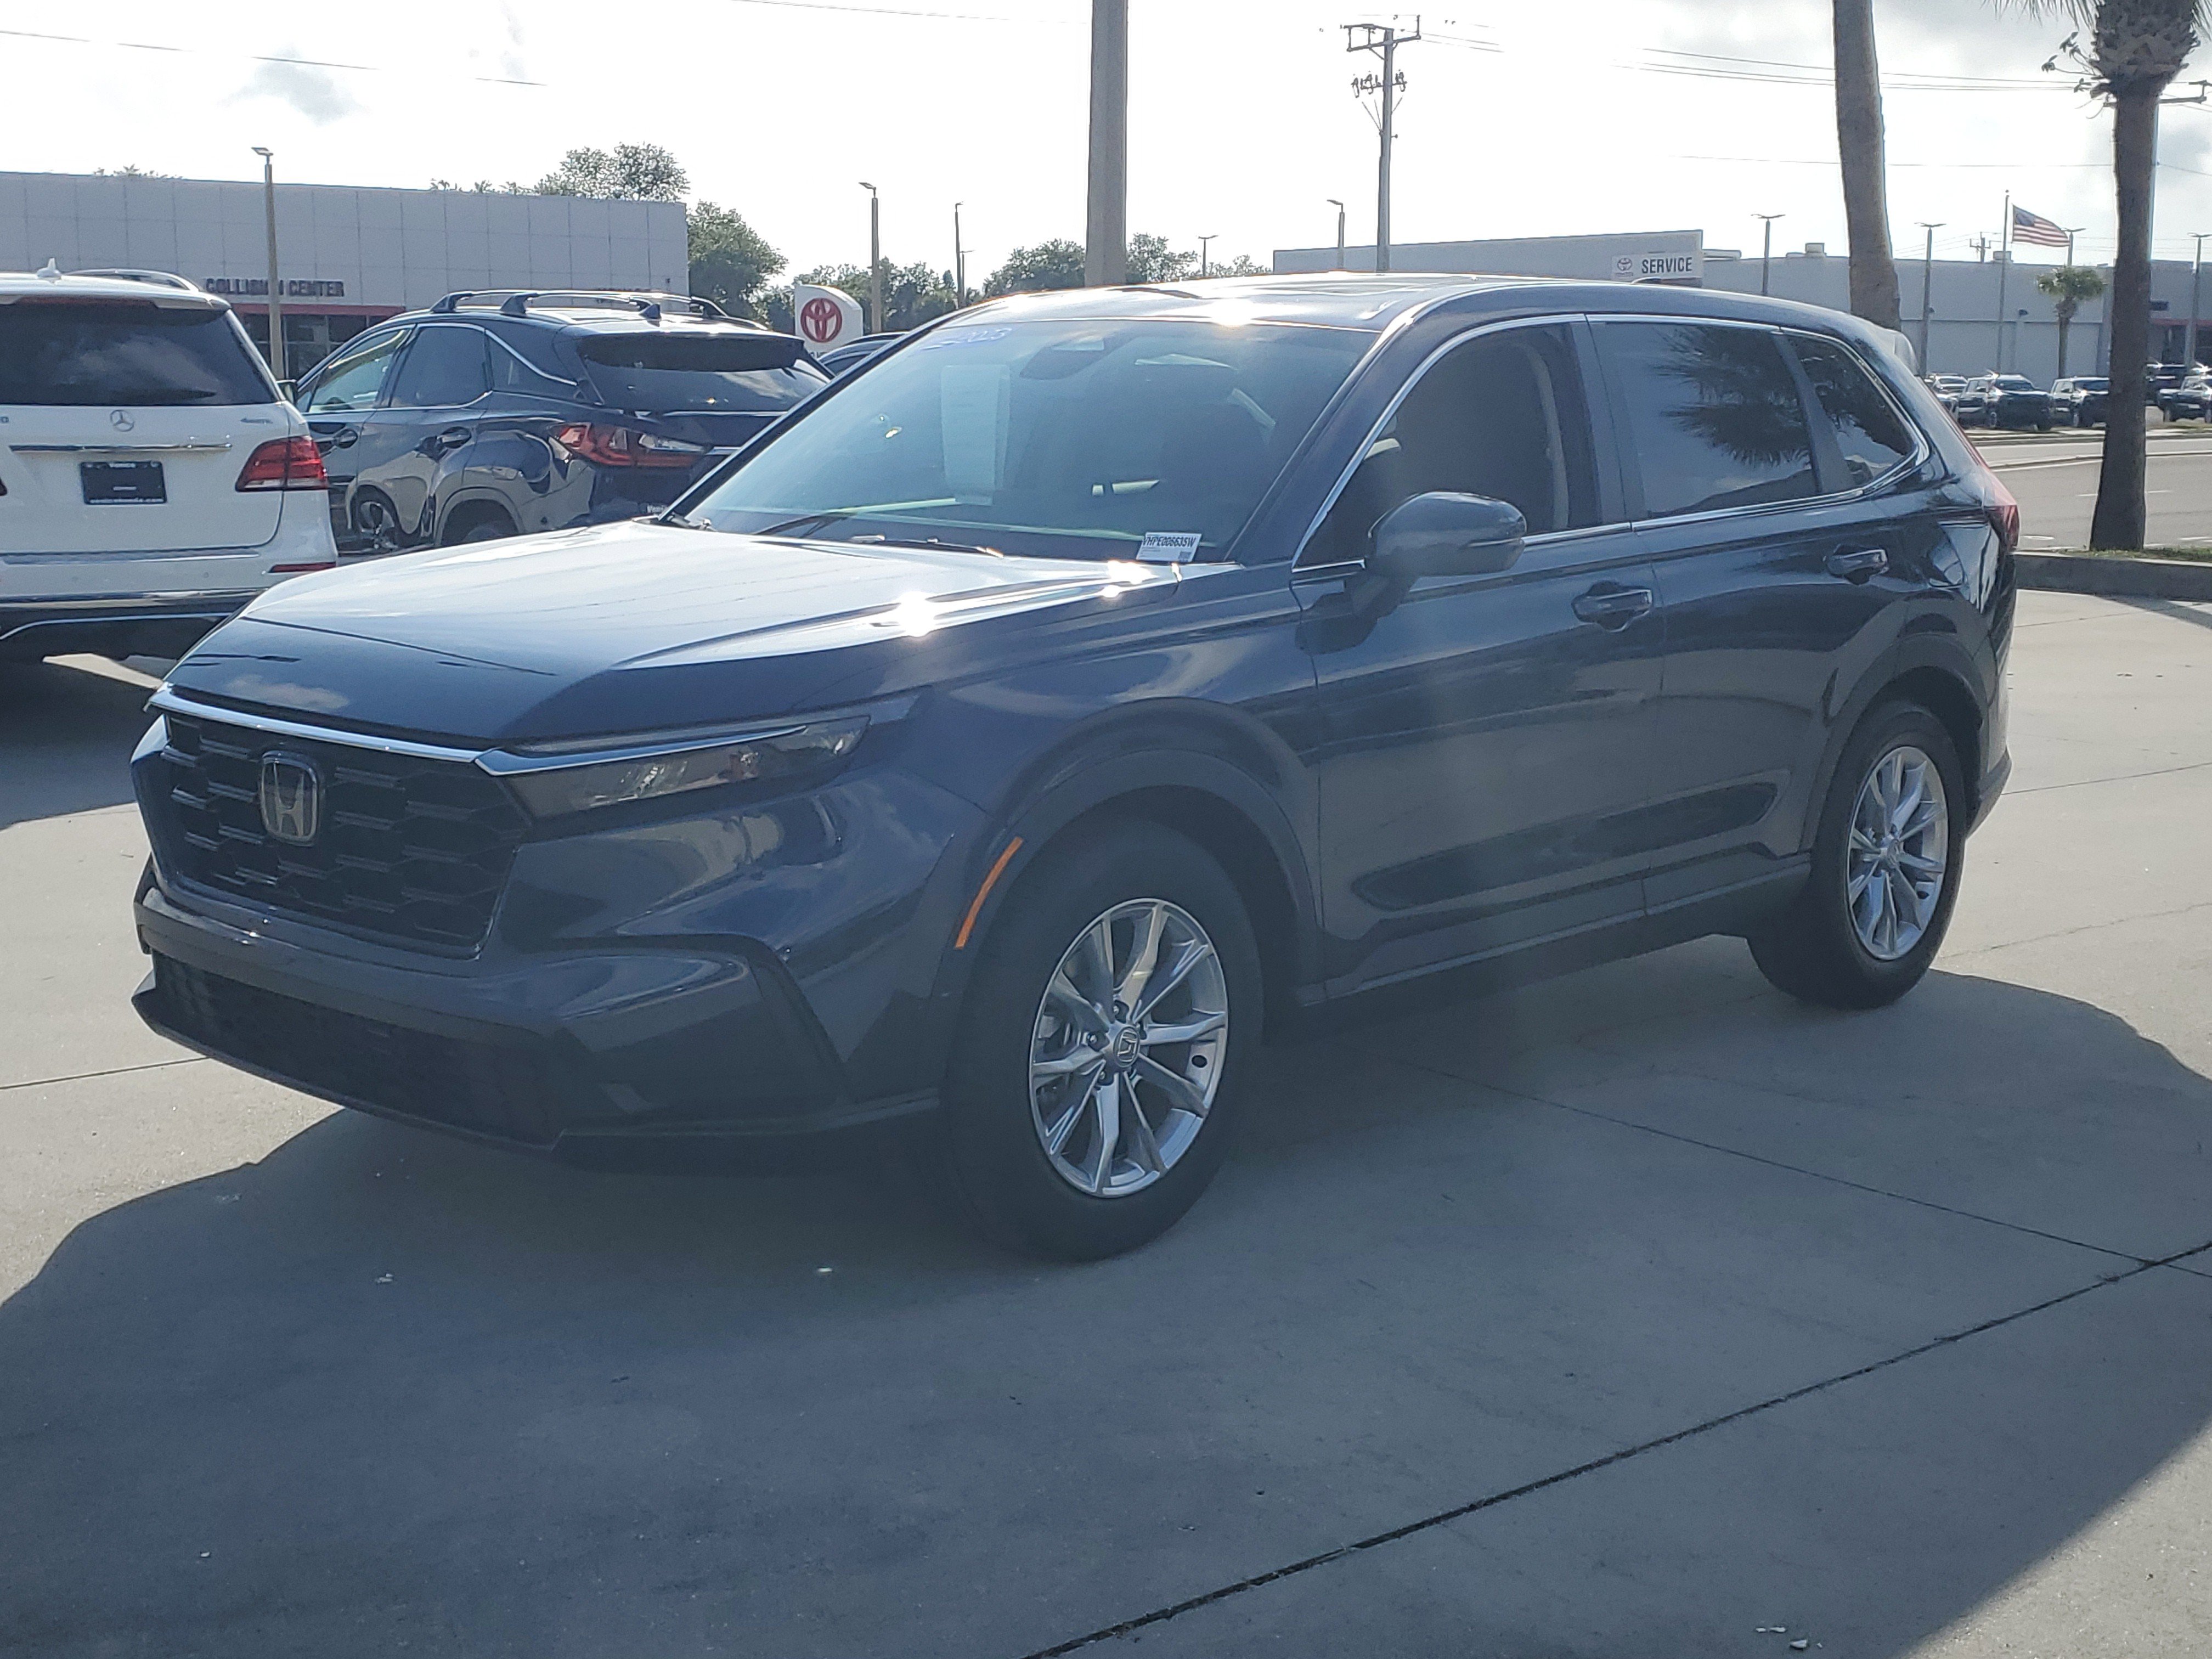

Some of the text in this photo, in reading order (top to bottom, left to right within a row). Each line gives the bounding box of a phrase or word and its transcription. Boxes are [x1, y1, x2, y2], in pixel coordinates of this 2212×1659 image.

[1641, 257, 1693, 274] SERVICE
[206, 278, 345, 297] COLLISIN CENTER
